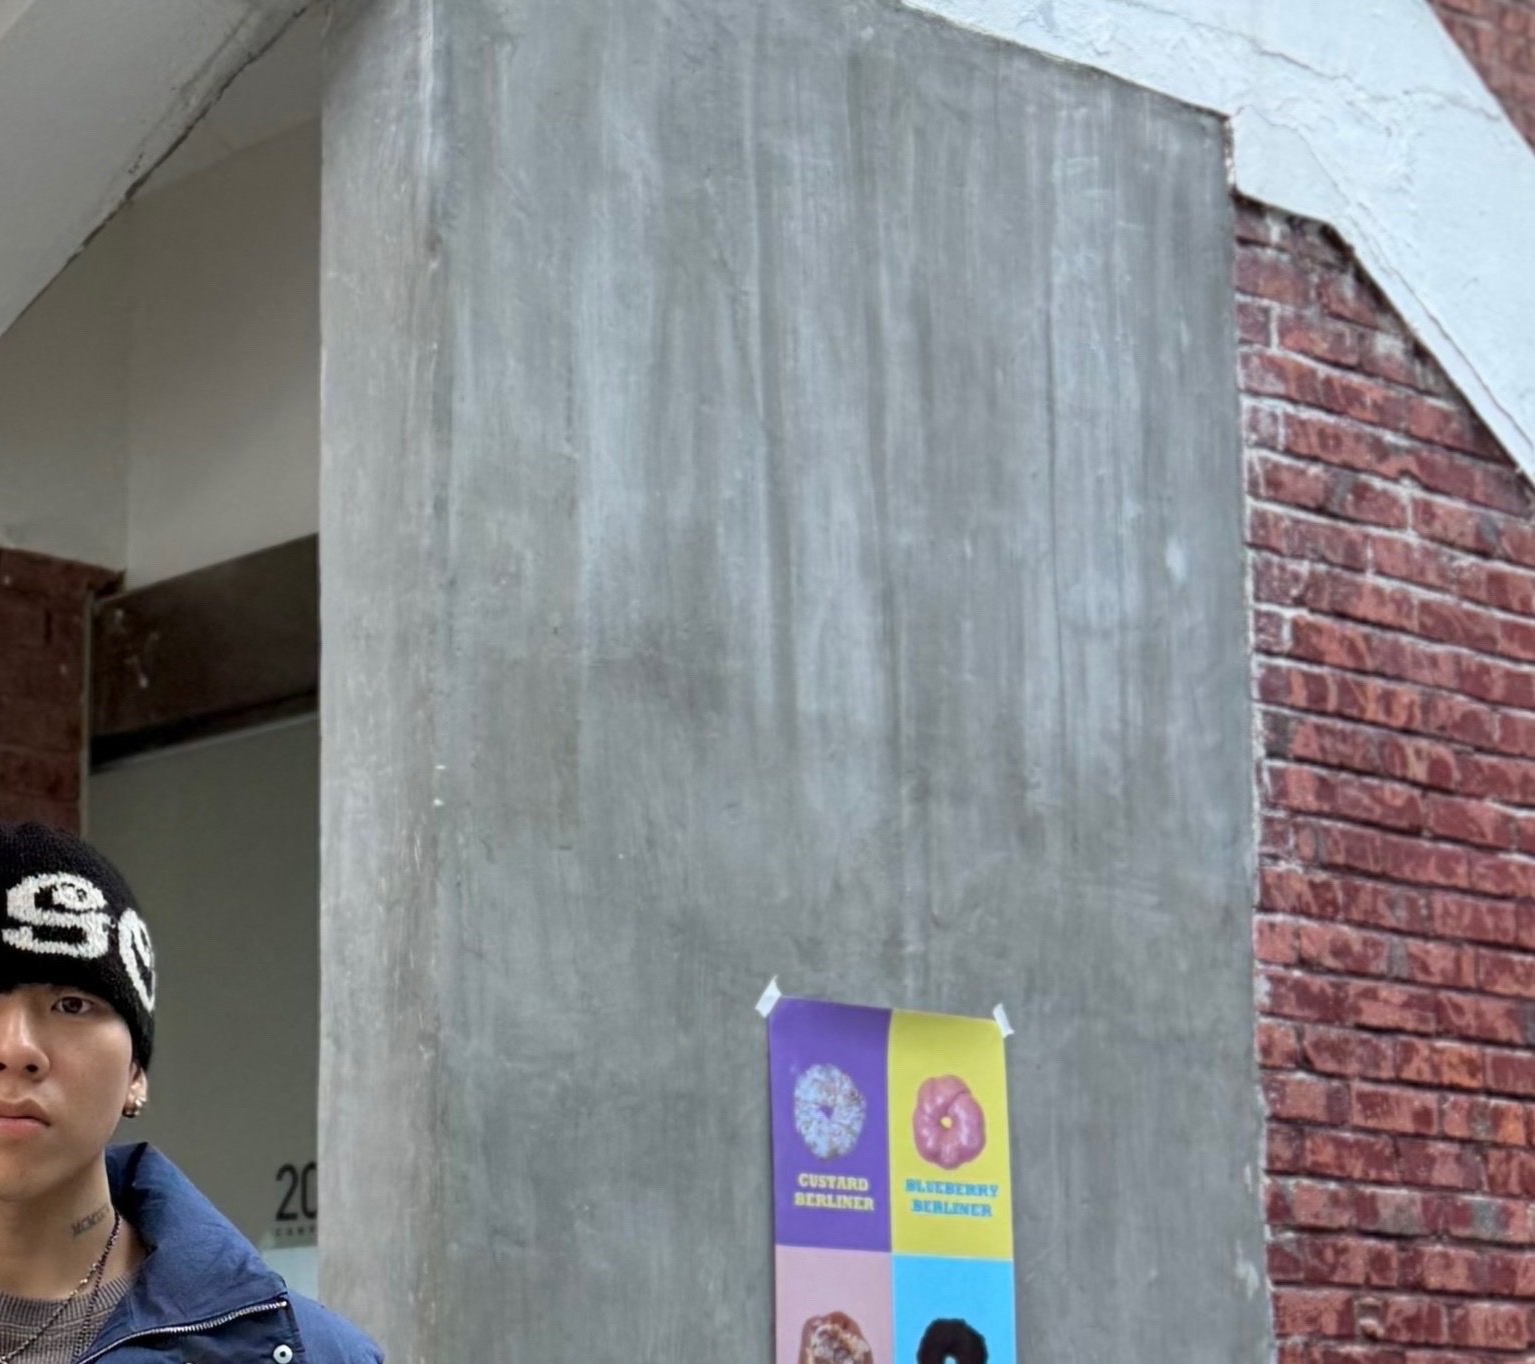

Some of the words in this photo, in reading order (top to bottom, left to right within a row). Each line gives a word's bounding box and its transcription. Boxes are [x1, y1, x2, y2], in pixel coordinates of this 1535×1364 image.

[798, 1173, 869, 1192] CUSTARD
[905, 1178, 999, 1198] BLUEBERRY
[794, 1192, 875, 1211] BERLINER
[911, 1198, 993, 1217] BERLINER
